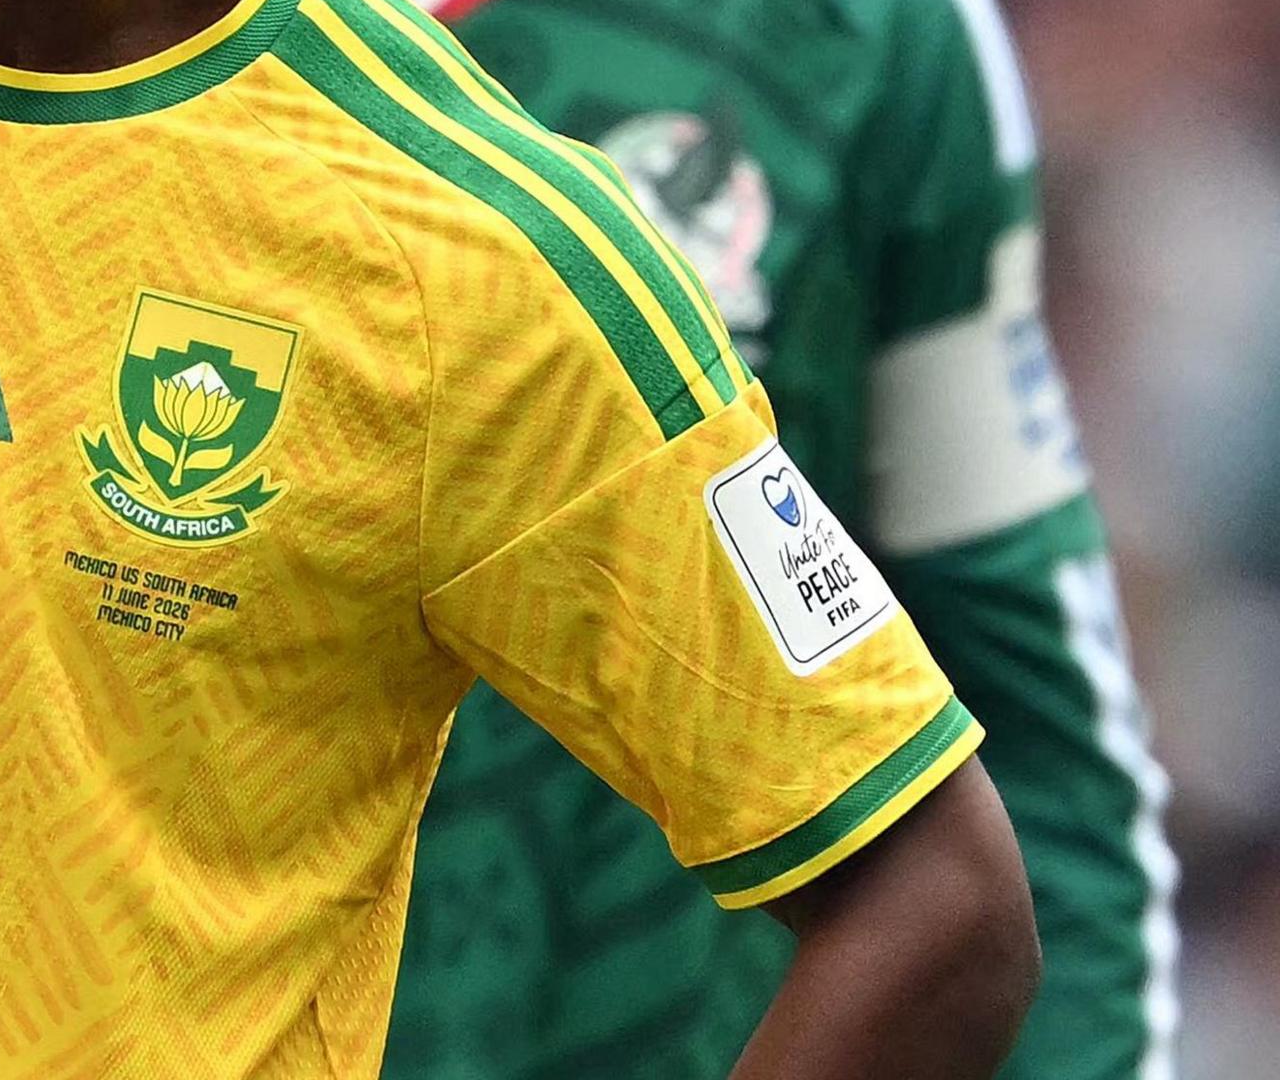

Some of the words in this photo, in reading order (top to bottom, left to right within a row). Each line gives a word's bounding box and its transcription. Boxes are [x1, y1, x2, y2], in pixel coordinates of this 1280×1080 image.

[101, 482, 161, 530] SOUTH
[161, 515, 236, 537] AFRICA
[64, 550, 118, 580] MEXICO
[143, 571, 187, 598] SOUTH
[189, 583, 239, 611] AFRICA
[101, 582, 114, 602] 11
[115, 586, 151, 611] JUNE
[153, 597, 191, 621] 2026
[797, 552, 858, 613] PEACE
[97, 604, 153, 633] MEXICO
[155, 620, 185, 642] CITY
[826, 597, 861, 627] FIFA
